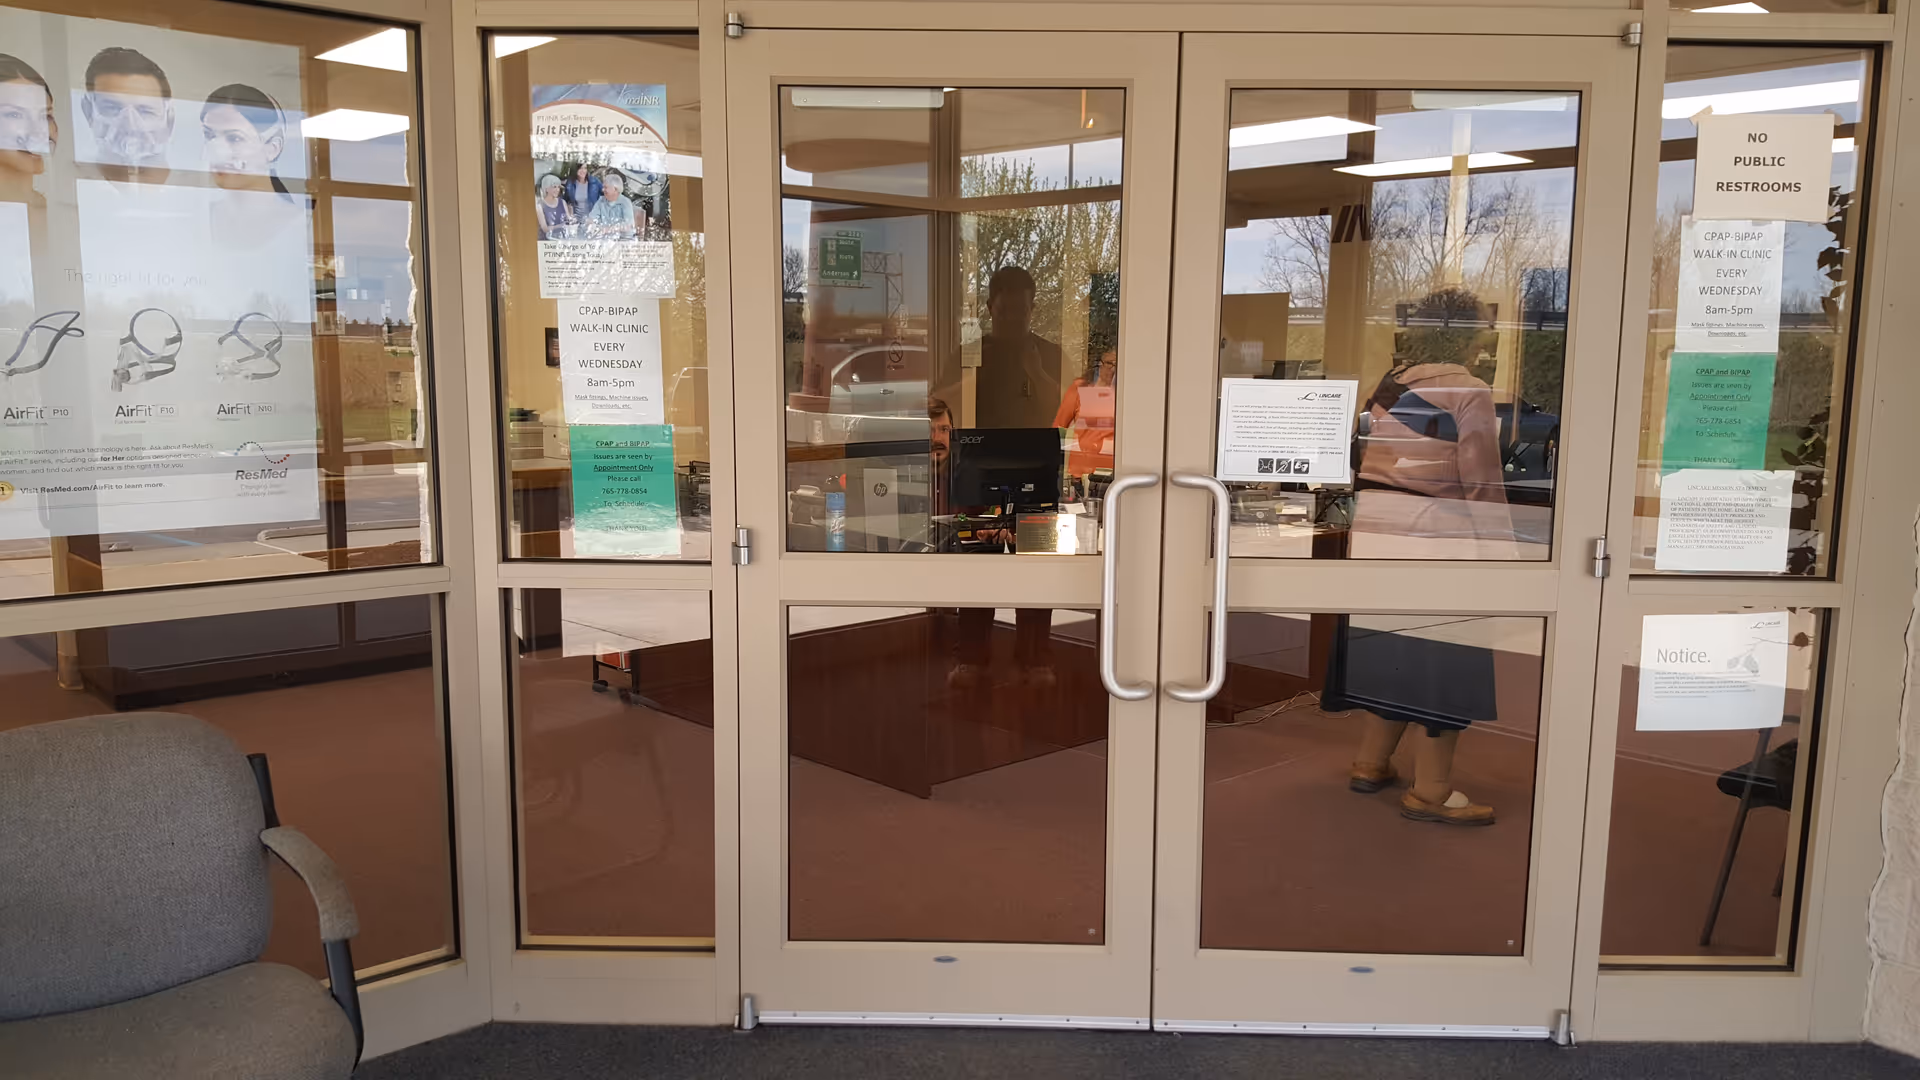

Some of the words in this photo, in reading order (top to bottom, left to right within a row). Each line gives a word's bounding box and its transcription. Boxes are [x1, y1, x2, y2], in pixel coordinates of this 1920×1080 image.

[536, 124, 545, 135] Is
[546, 124, 557, 135] It
[558, 124, 592, 138] Right
[594, 124, 614, 137] for
[615, 124, 646, 135] You?
[1747, 132, 1768, 143] NO
[1733, 156, 1786, 167] PUBLIC
[1715, 181, 1802, 193] RESTROOMS
[1703, 231, 1764, 241] CPAP-BIPAP
[1693, 249, 1737, 259] WALK-IN
[1740, 249, 1772, 259] CLINIC
[1716, 268, 1748, 278] EVERY
[1698, 286, 1763, 296] WEDNESDAY
[578, 305, 638, 316] CPAP-BIPAP
[1705, 304, 1753, 316] 8am-5pm
[569, 323, 613, 333] WALK-IN
[615, 323, 649, 334] CLINIC
[593, 342, 625, 352] EVERY
[578, 359, 643, 369] WEDNESDAY
[1695, 368, 1714, 376] CPAP
[1715, 368, 1729, 376] and
[1730, 369, 1751, 377] BIPAP
[587, 378, 635, 389] 8am-5pm
[1743, 382, 1752, 391] by
[1735, 393, 1752, 402] Only
[3, 406, 44, 420] AirFit
[52, 408, 69, 417] P10
[115, 404, 152, 418] AirFit
[160, 406, 175, 415] F10
[216, 402, 251, 416] AirFit
[257, 405, 273, 413] N10
[1702, 404, 1723, 412] Please
[595, 440, 614, 448] CPAP
[615, 440, 628, 448] and
[629, 440, 650, 448] BIPAP
[959, 436, 985, 445] acer
[644, 453, 653, 461] by
[593, 464, 637, 473] Appointment
[638, 464, 654, 473] Only
[235, 468, 289, 481] ResMed
[20, 486, 39, 494] Visit
[40, 484, 113, 494] ResMed.com/AirFit
[601, 487, 648, 495] 765-778-0854
[874, 483, 888, 498] hp
[1656, 647, 1711, 664] Notice.
